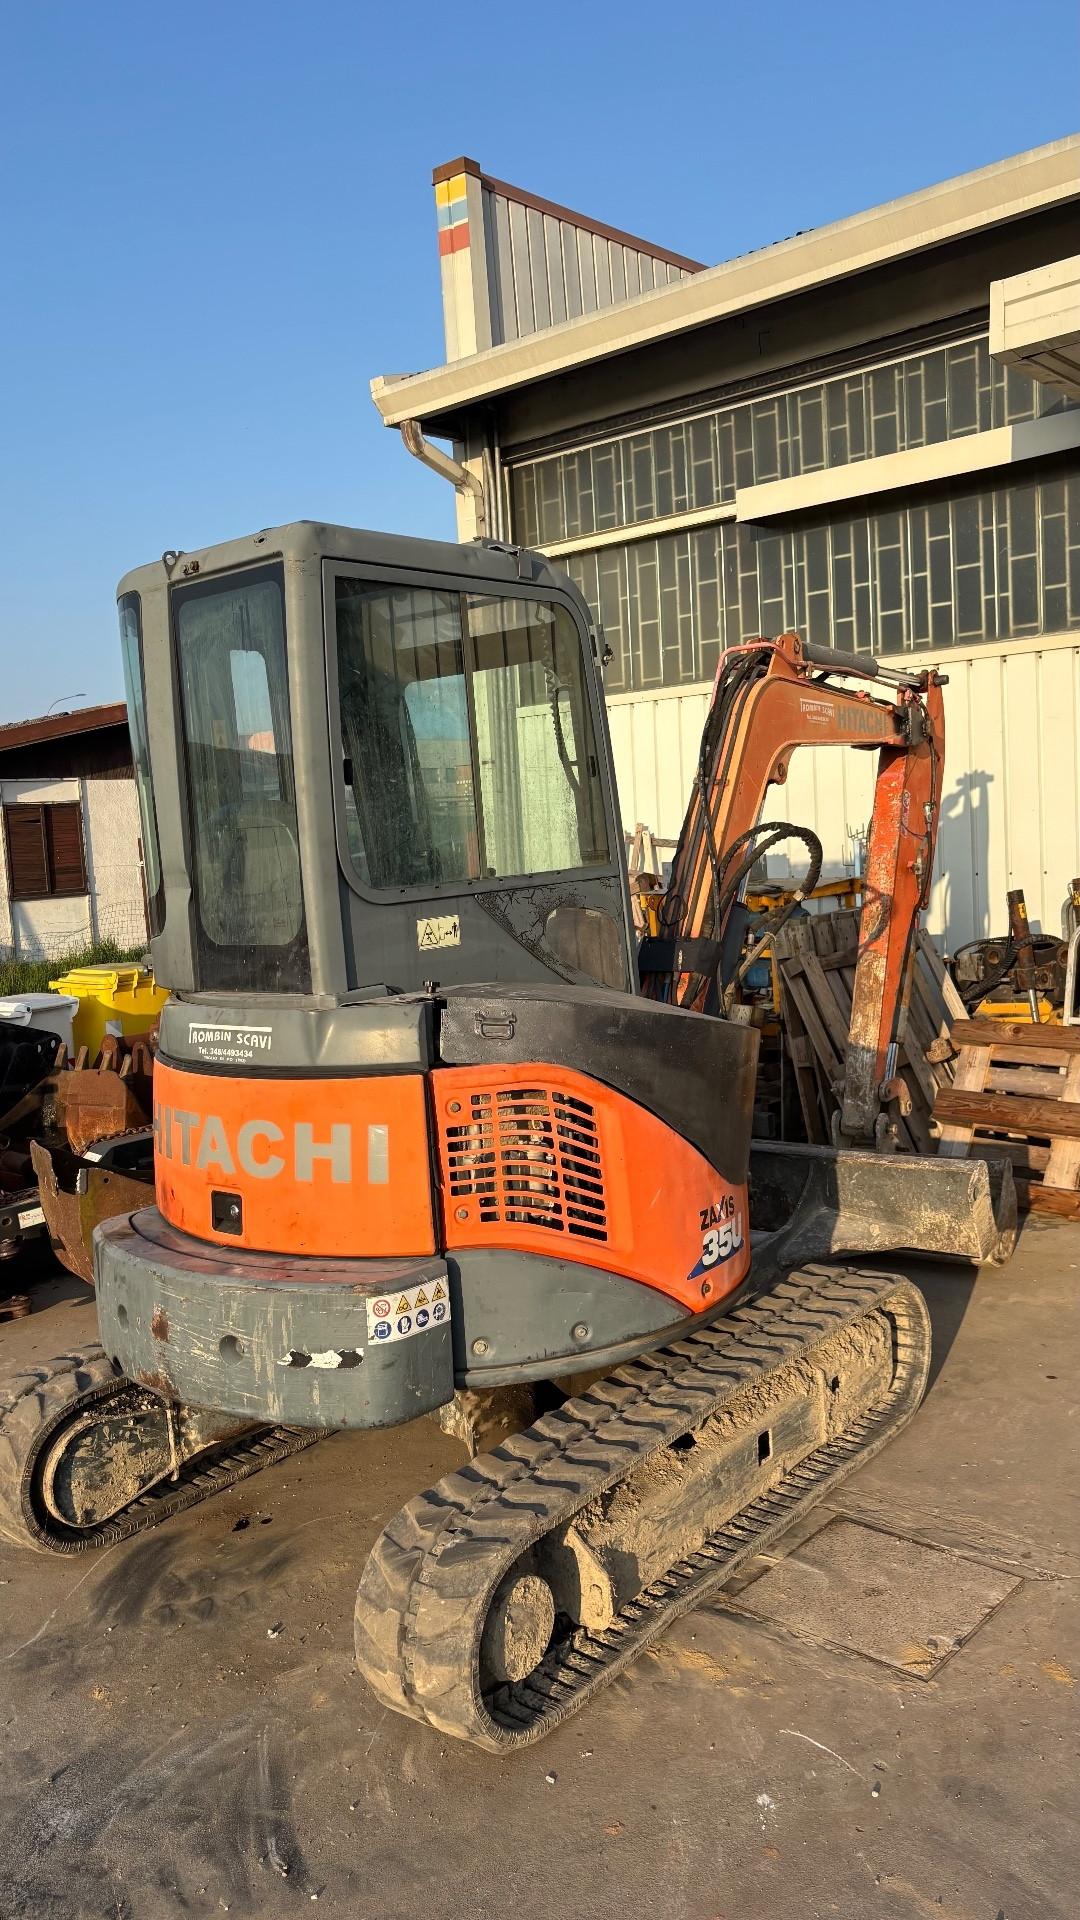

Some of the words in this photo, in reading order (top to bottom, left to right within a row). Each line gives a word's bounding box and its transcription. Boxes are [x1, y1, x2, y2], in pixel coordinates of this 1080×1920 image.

[198, 1046, 209, 1055] Tel.
[236, 1033, 272, 1050] SCAVI
[153, 1101, 389, 1184] HITACHI
[699, 1195, 735, 1231] ZAXIS
[702, 1212, 742, 1266] 35U
